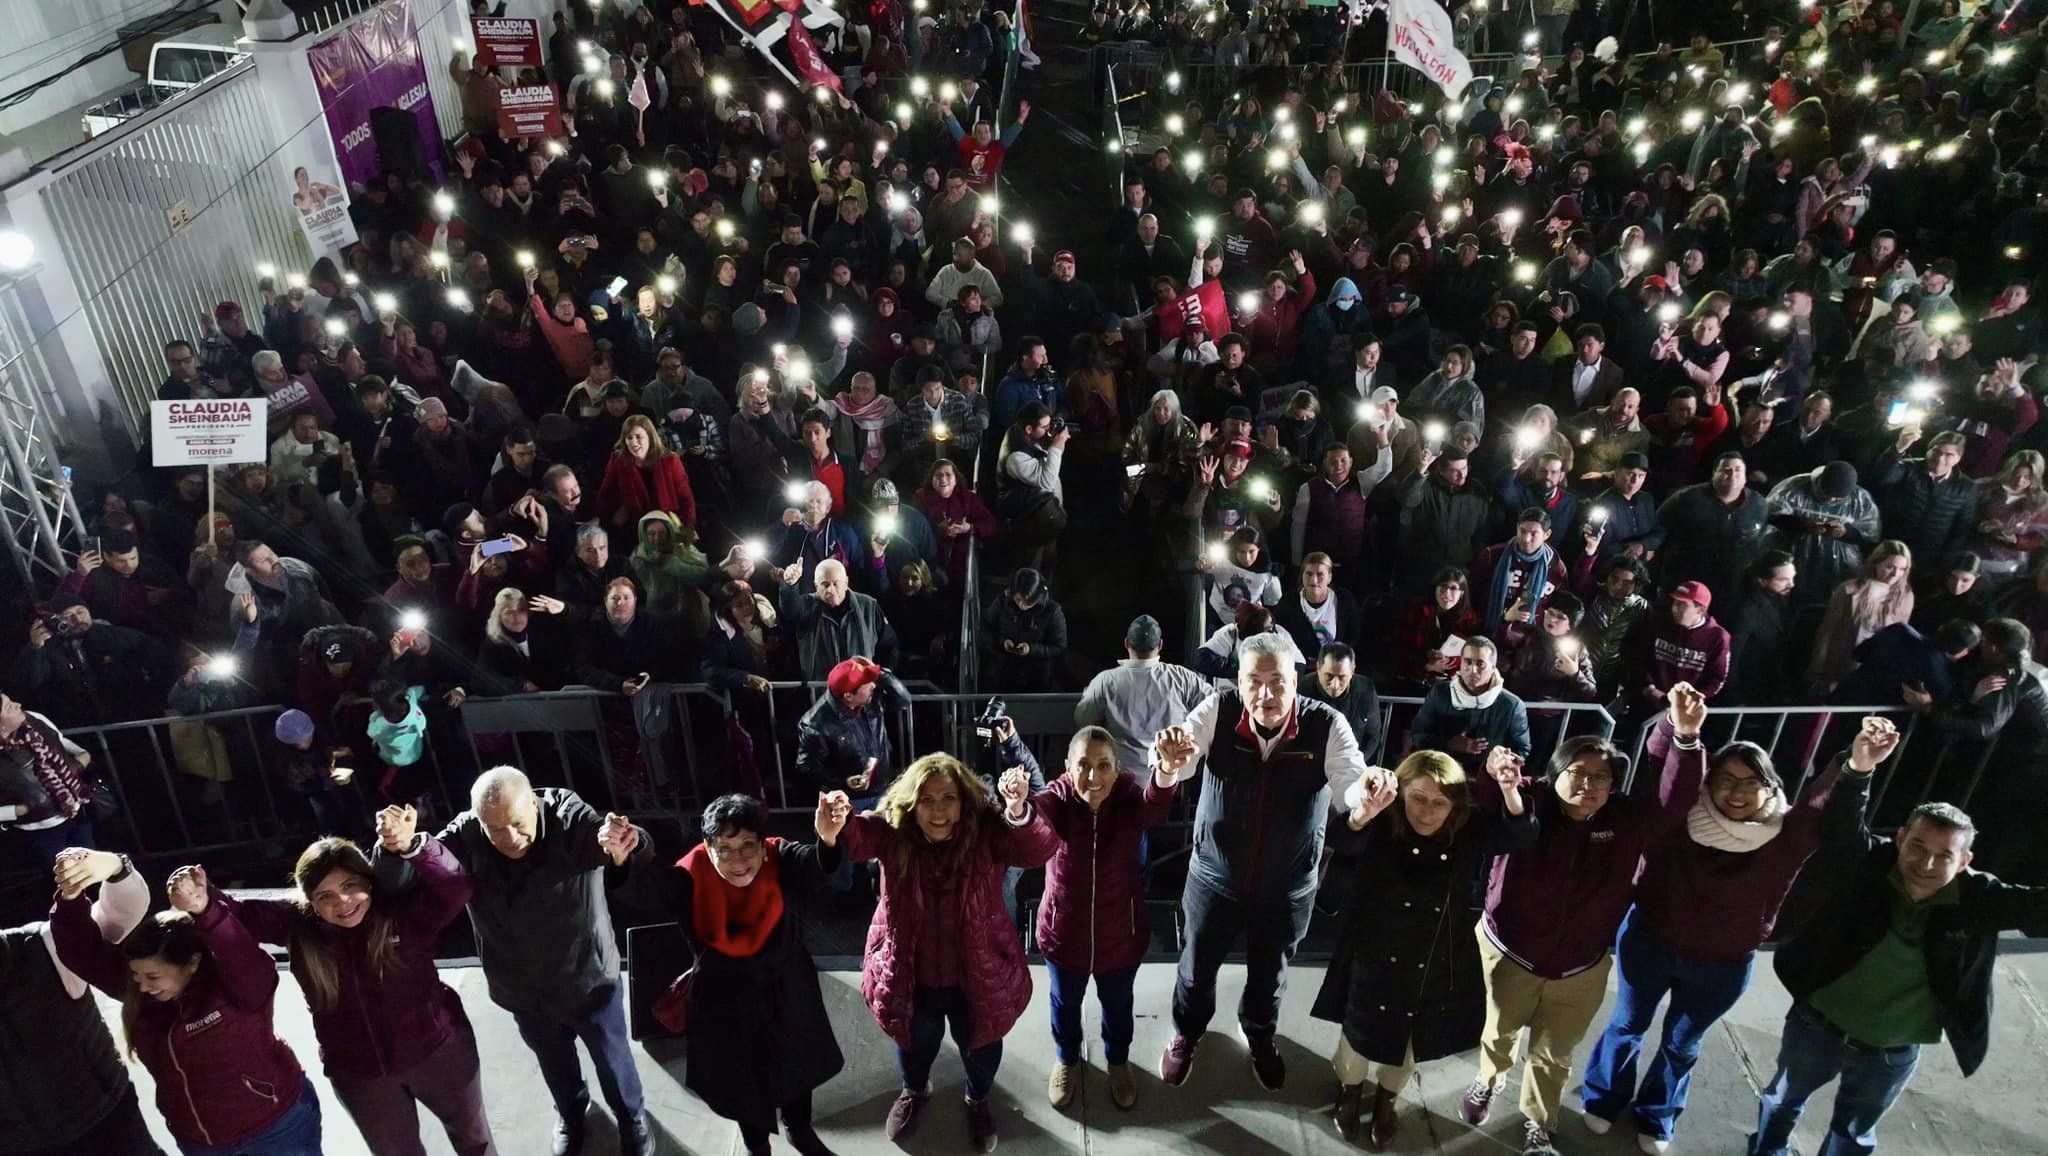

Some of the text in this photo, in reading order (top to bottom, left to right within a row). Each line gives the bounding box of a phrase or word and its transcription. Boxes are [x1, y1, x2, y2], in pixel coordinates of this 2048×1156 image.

[477, 20, 532, 30] CLAUDIA
[500, 86, 552, 98] CLAUDIA
[168, 402, 251, 414] CLAUDIA
[168, 414, 252, 424] SHEINBAUM
[188, 447, 233, 456] morena
[1655, 638, 1706, 662] morena
[185, 1010, 221, 1032] morena
